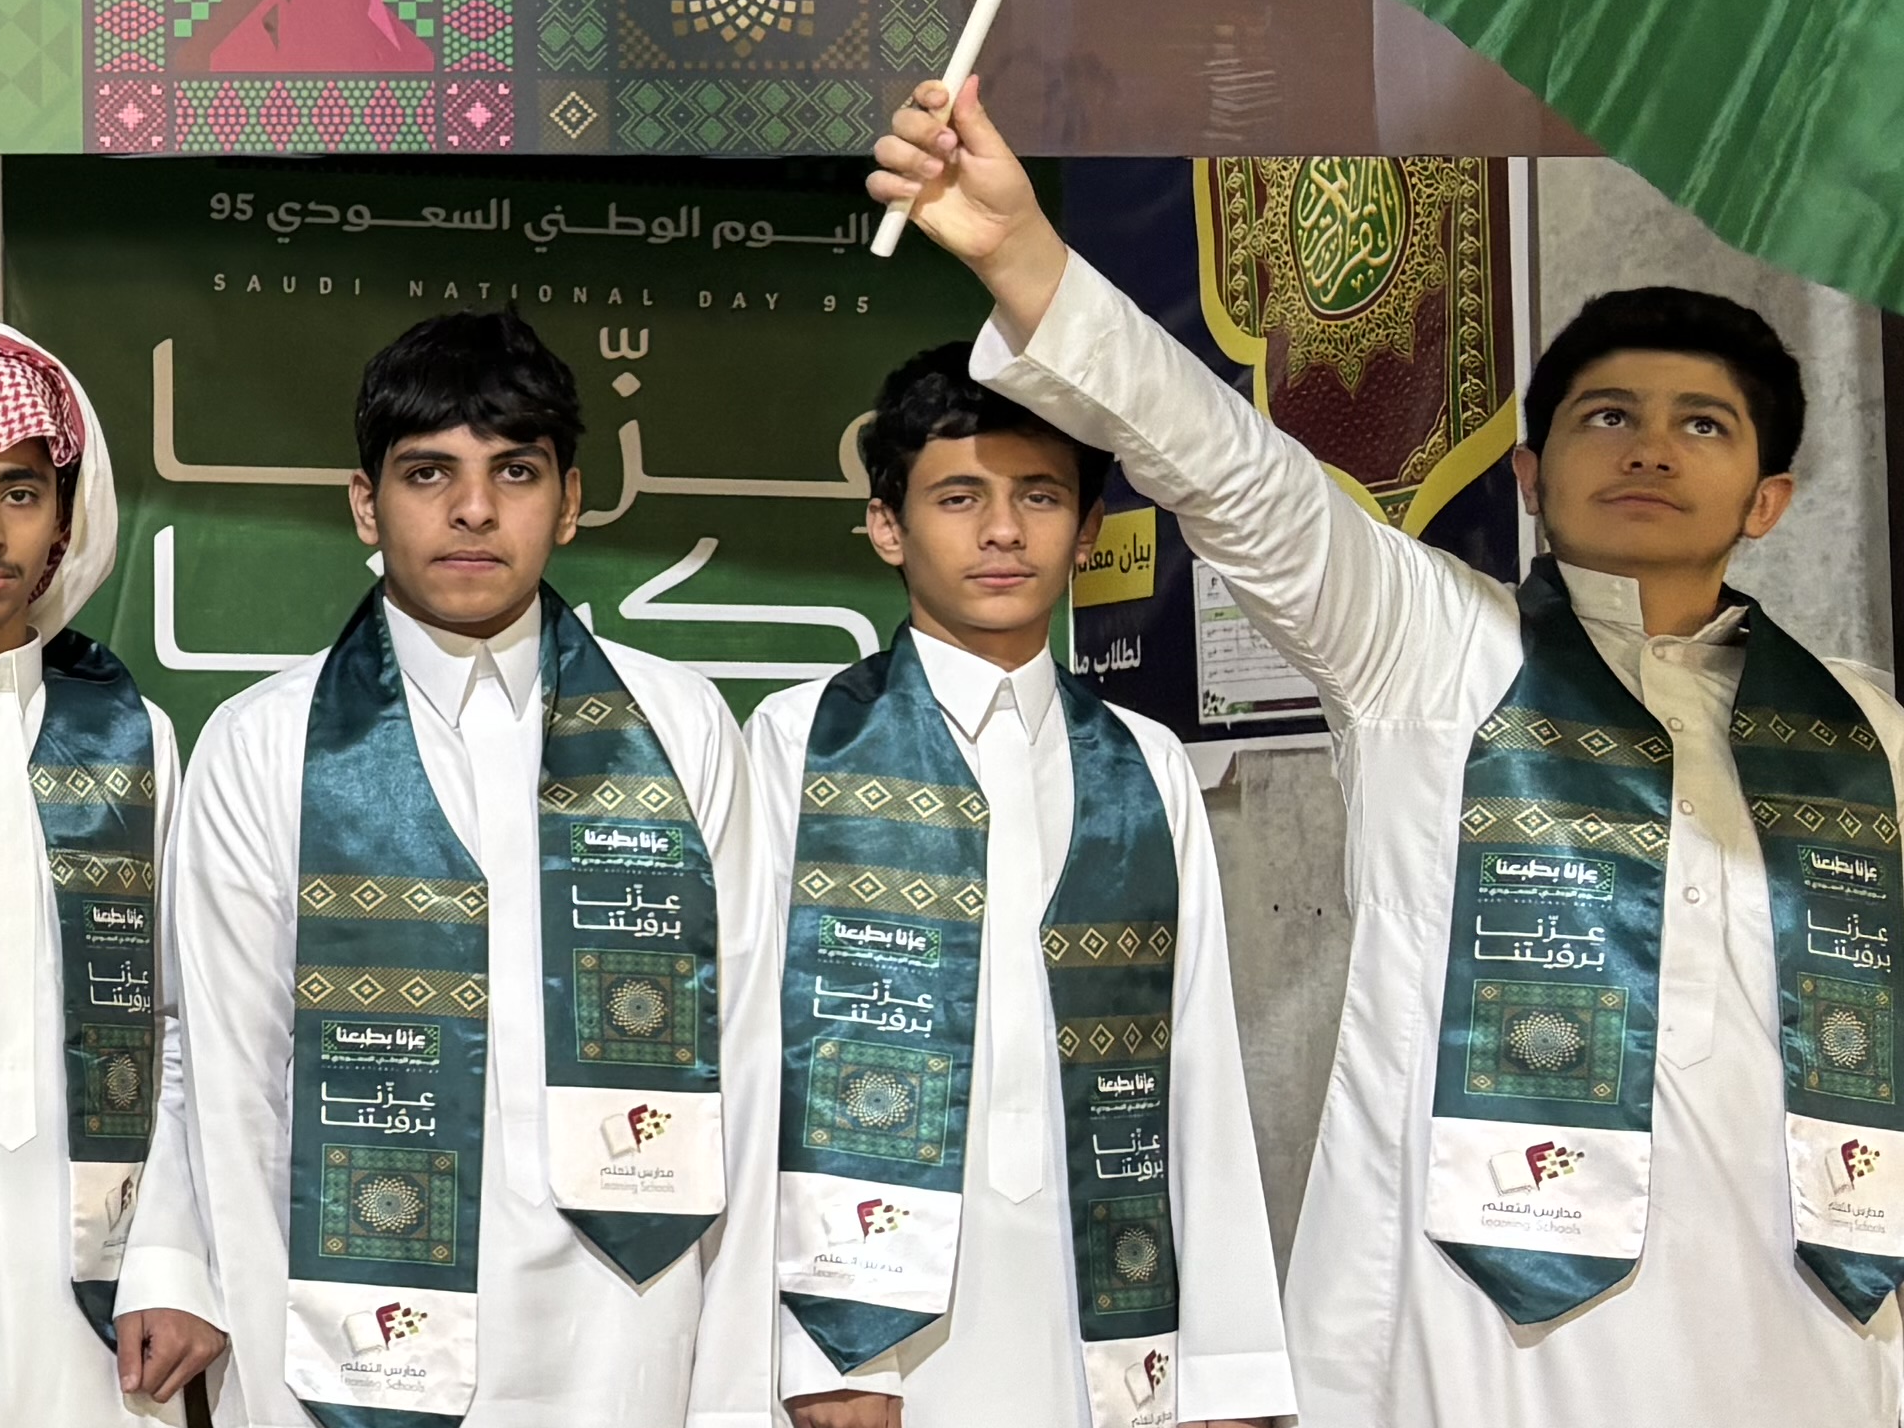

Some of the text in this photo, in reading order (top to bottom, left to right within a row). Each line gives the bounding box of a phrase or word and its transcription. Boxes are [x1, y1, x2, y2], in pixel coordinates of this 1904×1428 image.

[209, 192, 869, 255] اليوم الوطني السعودي 95
[213, 273, 870, 315] SAUDI NATIONAL DAY 95
[1094, 634, 1142, 683] لطلاب
